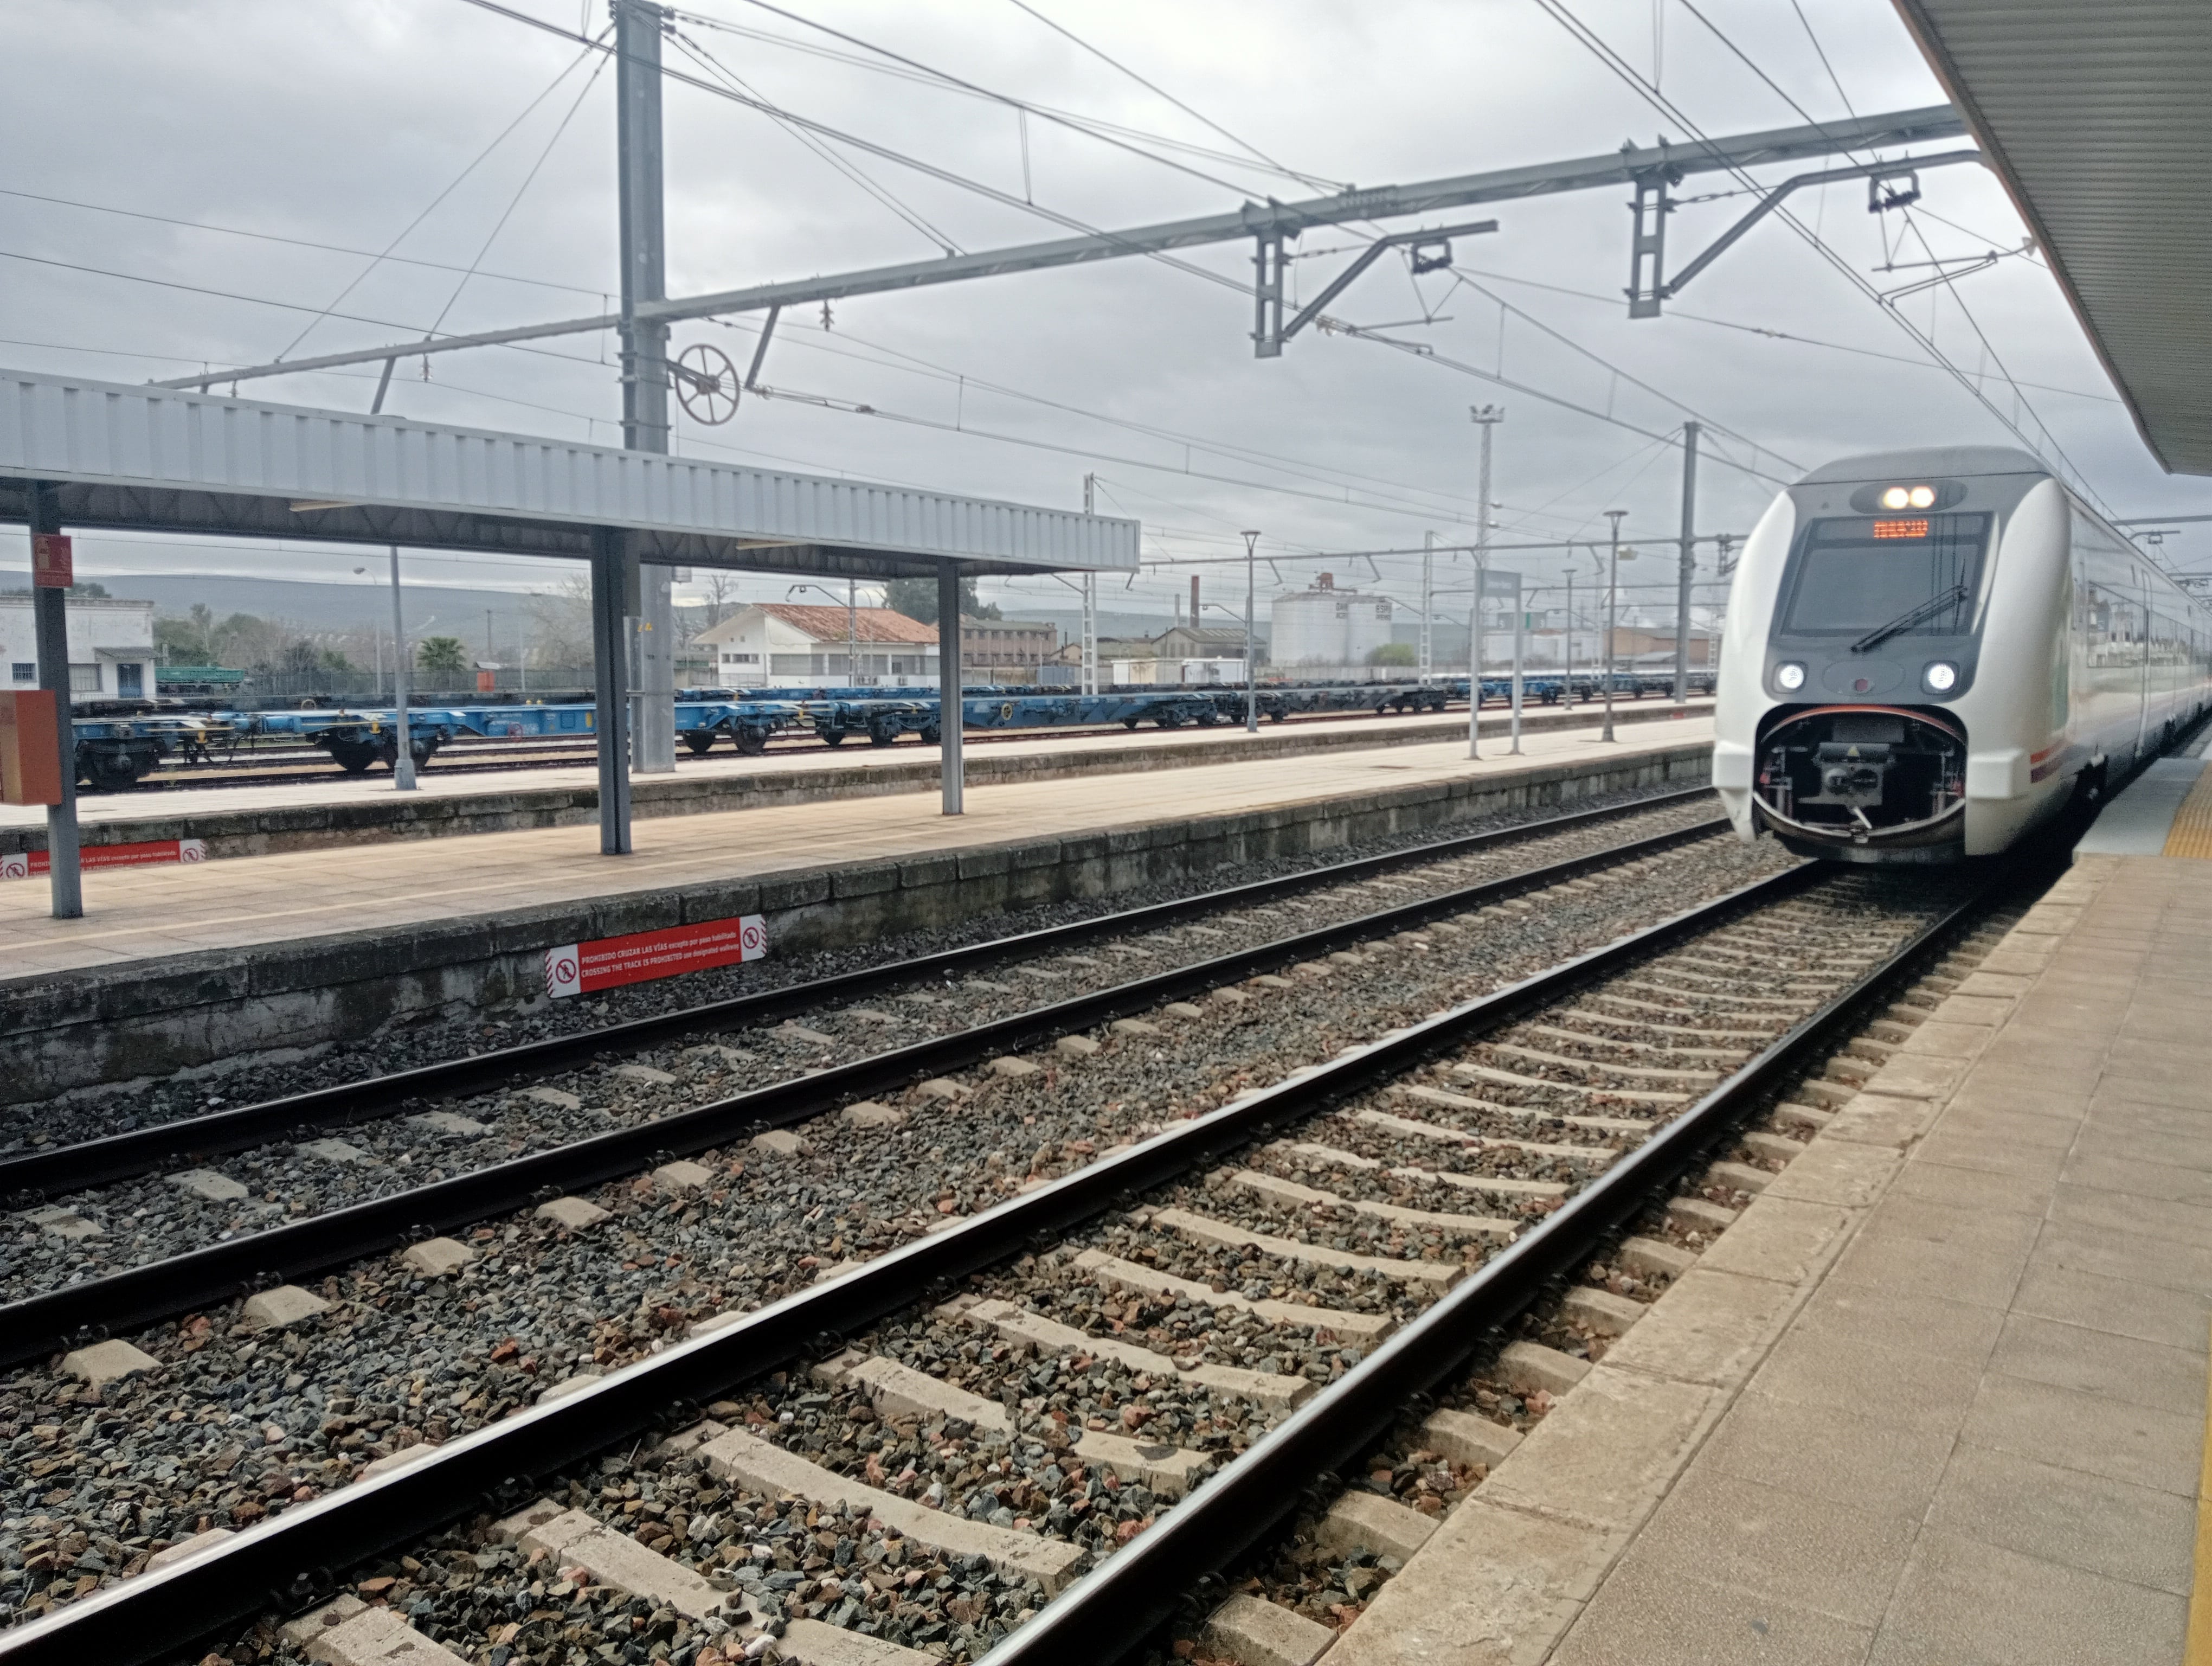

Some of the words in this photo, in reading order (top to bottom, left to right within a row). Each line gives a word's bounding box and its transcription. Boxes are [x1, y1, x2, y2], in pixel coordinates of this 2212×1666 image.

[581, 952, 617, 965] PROHIBIDO
[617, 947, 641, 958] CRUZAR
[641, 945, 653, 954] LAS
[653, 942, 668, 952] VÍAS
[689, 939, 698, 947] por
[581, 965, 611, 978] CROSSING
[612, 963, 623, 972] THE
[623, 959, 642, 970] TRACK
[642, 958, 650, 966] IS
[650, 952, 683, 965] PROHIBITED
